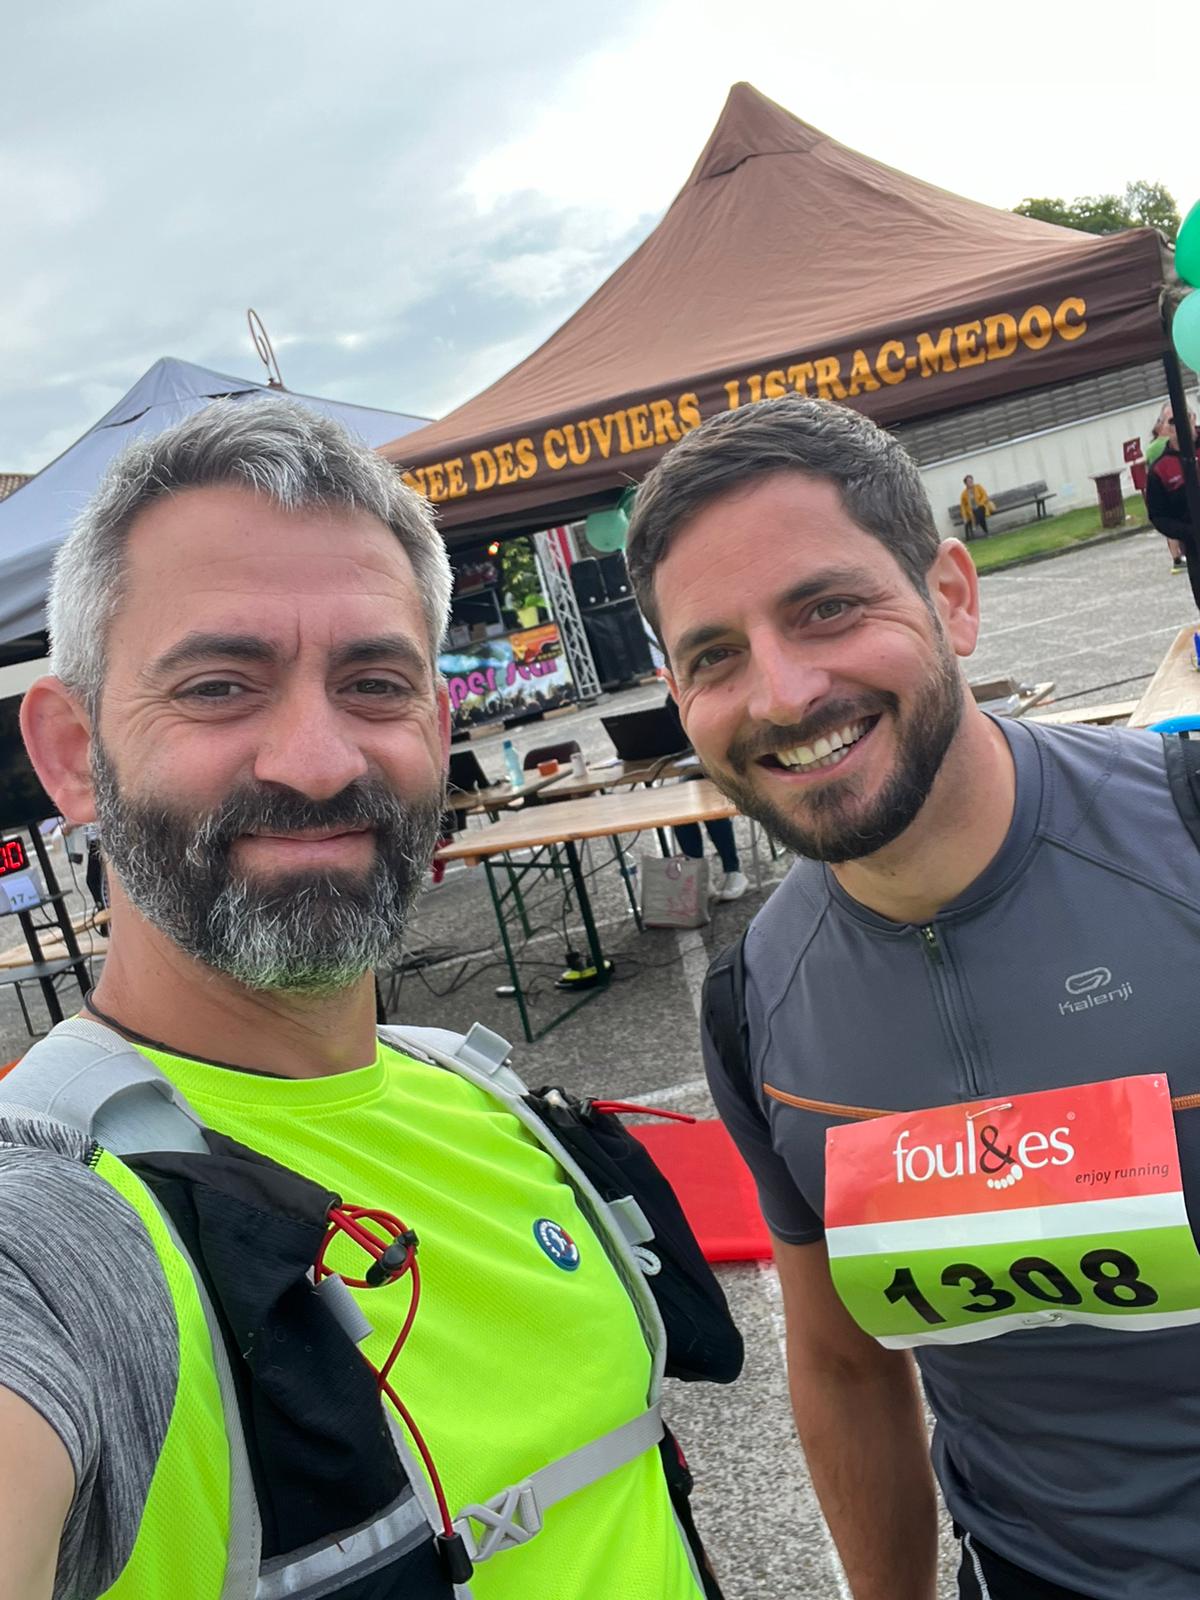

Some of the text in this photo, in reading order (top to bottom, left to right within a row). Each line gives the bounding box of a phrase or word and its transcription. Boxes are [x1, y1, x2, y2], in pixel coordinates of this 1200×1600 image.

[470, 437, 538, 491] DES
[542, 392, 701, 471] CUVIERS
[1058, 982, 1133, 1015] Kalenji
[893, 1118, 1075, 1185] foul&es
[1074, 1162, 1169, 1185] enjoy running
[883, 1248, 1159, 1325] 1308
